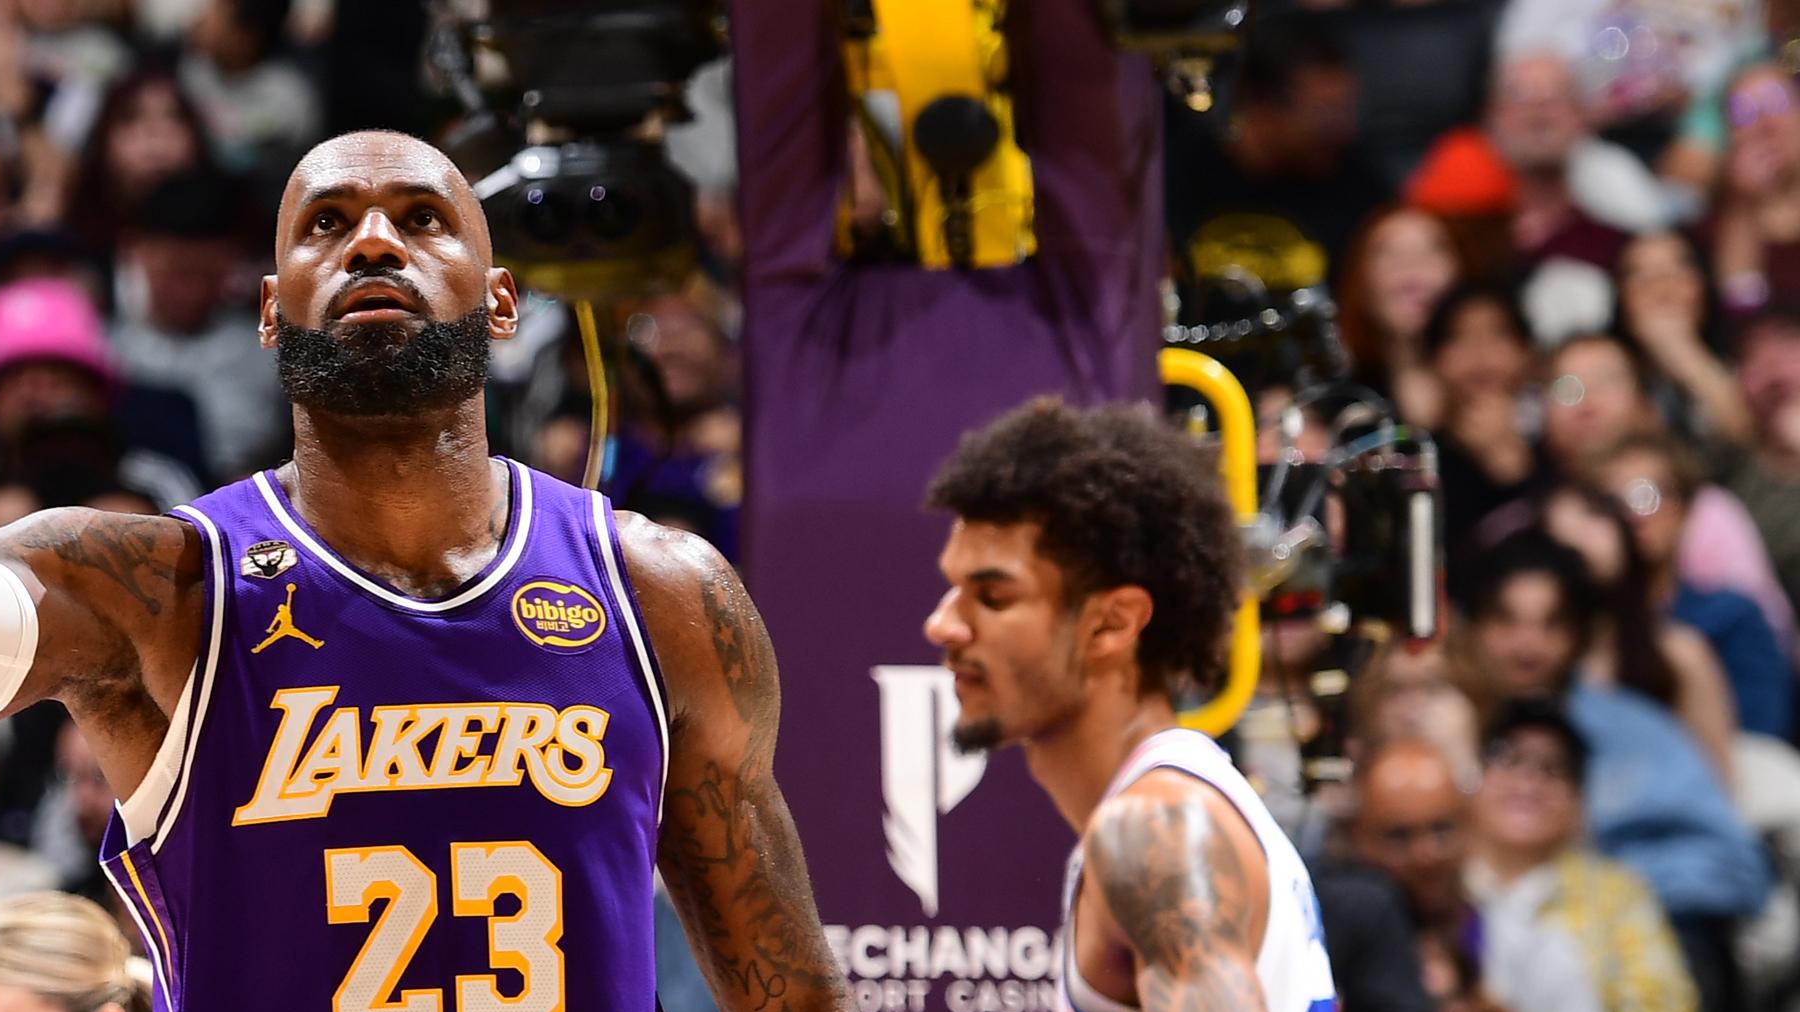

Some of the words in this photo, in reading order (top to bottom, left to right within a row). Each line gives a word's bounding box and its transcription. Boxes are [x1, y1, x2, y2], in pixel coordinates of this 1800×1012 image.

[520, 597, 599, 629] bibigo
[232, 685, 613, 826] LAKERS
[823, 924, 1064, 981] CHANG
